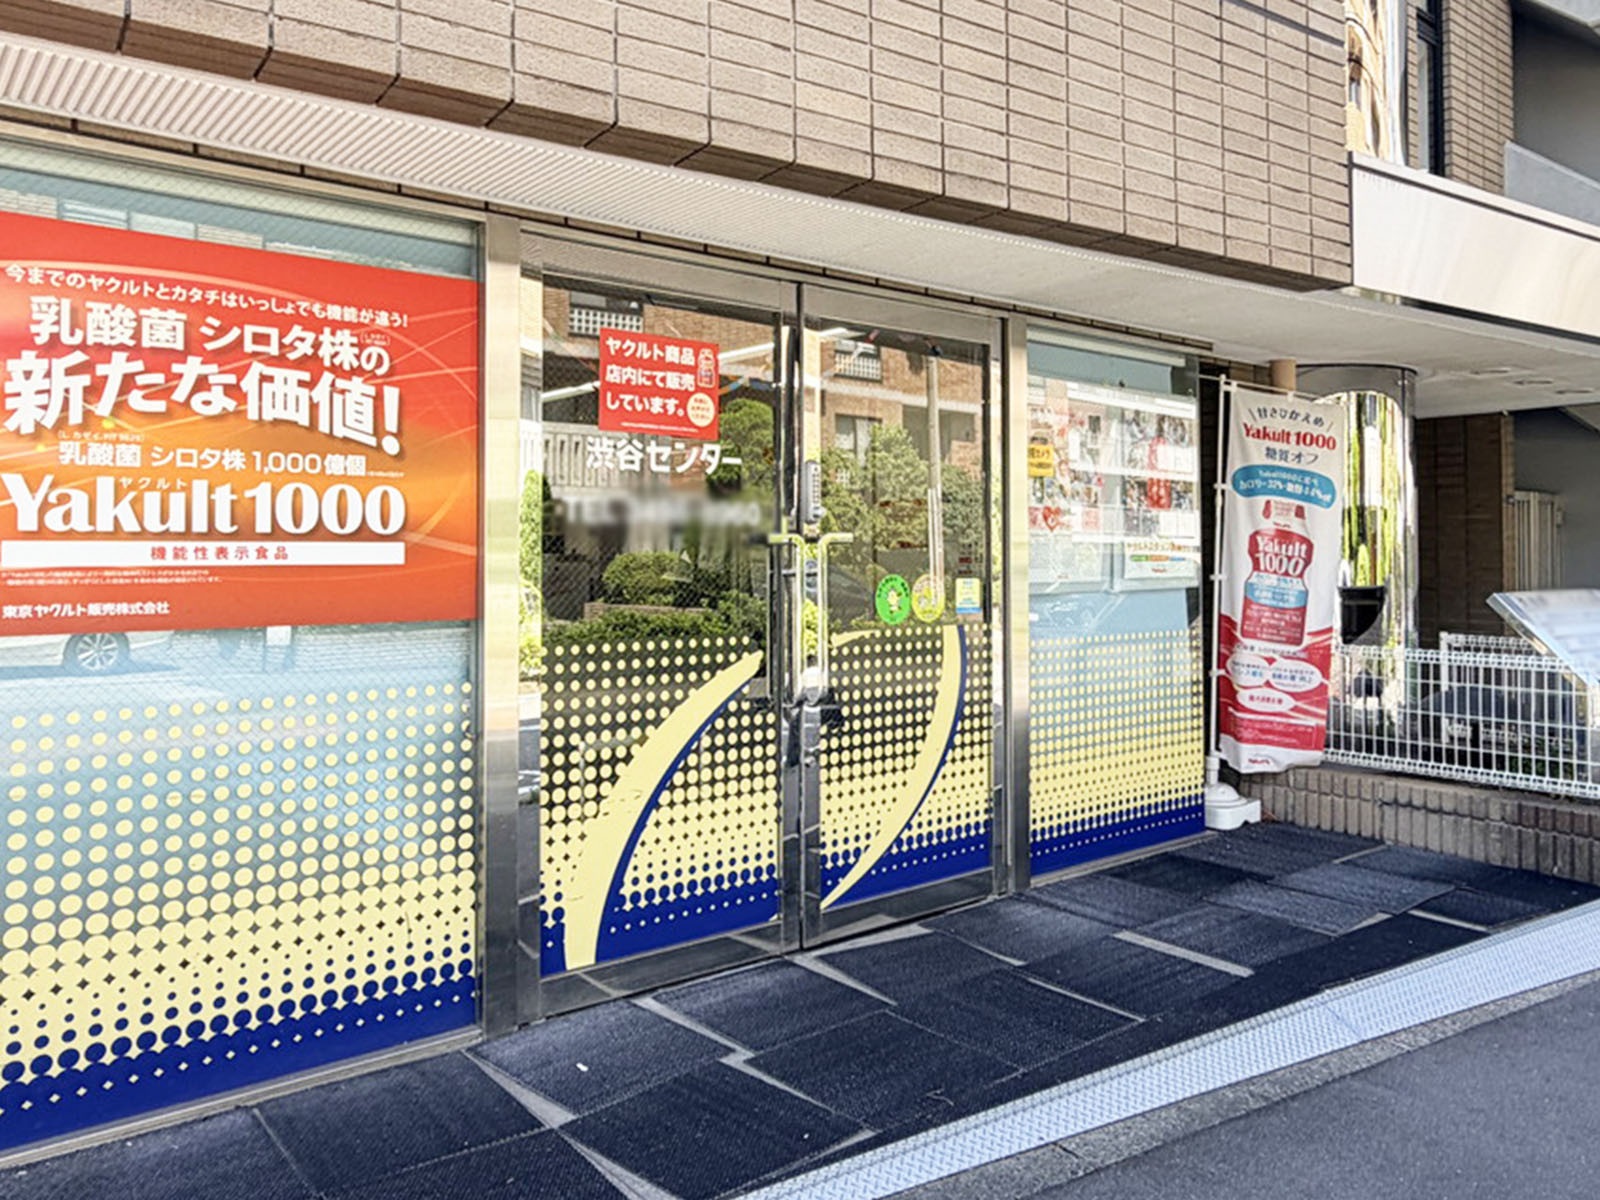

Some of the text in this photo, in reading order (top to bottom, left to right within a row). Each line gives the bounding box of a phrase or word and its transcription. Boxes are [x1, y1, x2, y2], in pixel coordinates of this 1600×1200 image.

[29, 295, 188, 350] 乳酸菌
[605, 337, 695, 366] ヤクルト商品
[605, 364, 696, 392] 店内にて販売
[3, 350, 402, 457] 新たな価値!
[606, 391, 685, 417] しています。
[58, 441, 142, 467] 乳酸菌
[150, 446, 246, 472] シロタ株
[586, 436, 743, 475] 渋谷センター
[119, 477, 188, 490] ヤクルト
[150, 545, 289, 561] 機能性表示食品
[1256, 533, 1308, 558] Yakult
[1256, 551, 1305, 577] 1000
